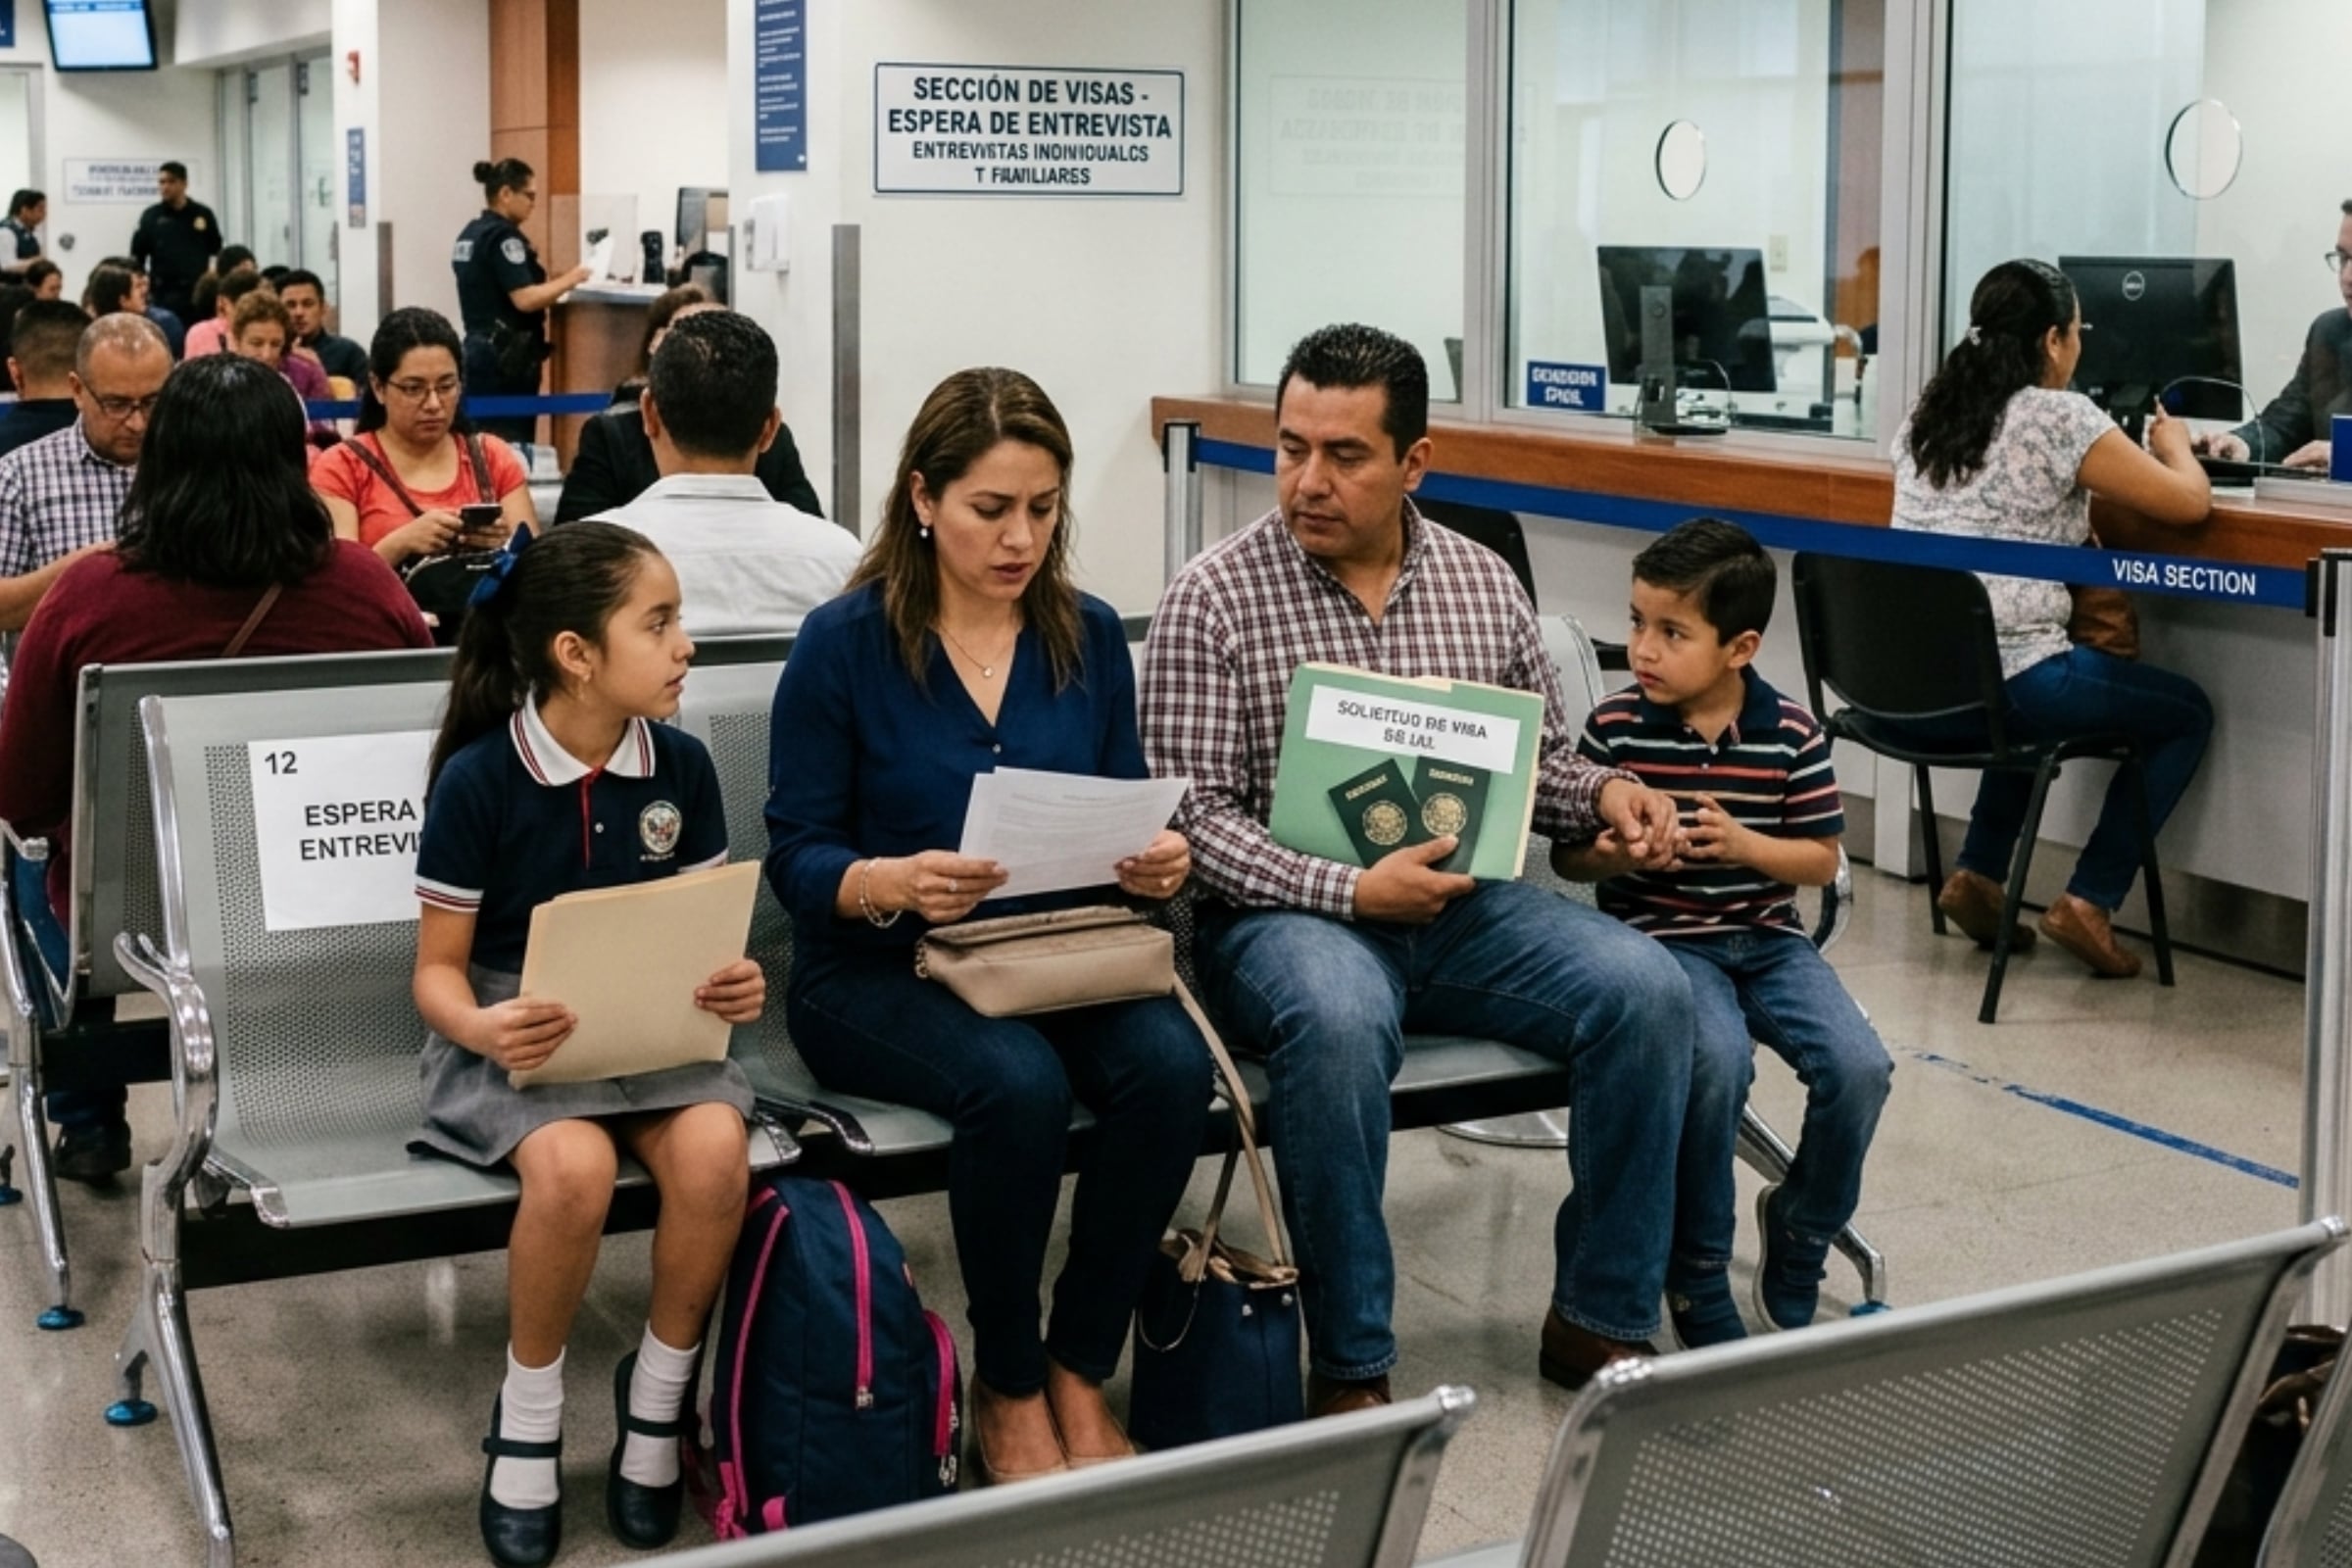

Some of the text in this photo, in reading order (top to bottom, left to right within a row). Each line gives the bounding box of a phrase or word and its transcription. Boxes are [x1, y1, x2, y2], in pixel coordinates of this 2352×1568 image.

[913, 74, 1020, 103] SECCIÓN
[1029, 79, 1058, 103] DE
[1065, 80, 1135, 105] VISAS
[889, 109, 1173, 138] ESPERA DE ENTREVISTA
[2113, 559, 2256, 596] VISA SECTION
[265, 751, 298, 774] 12
[304, 798, 416, 827] ESPERA
[300, 831, 422, 860] ENTREVI
